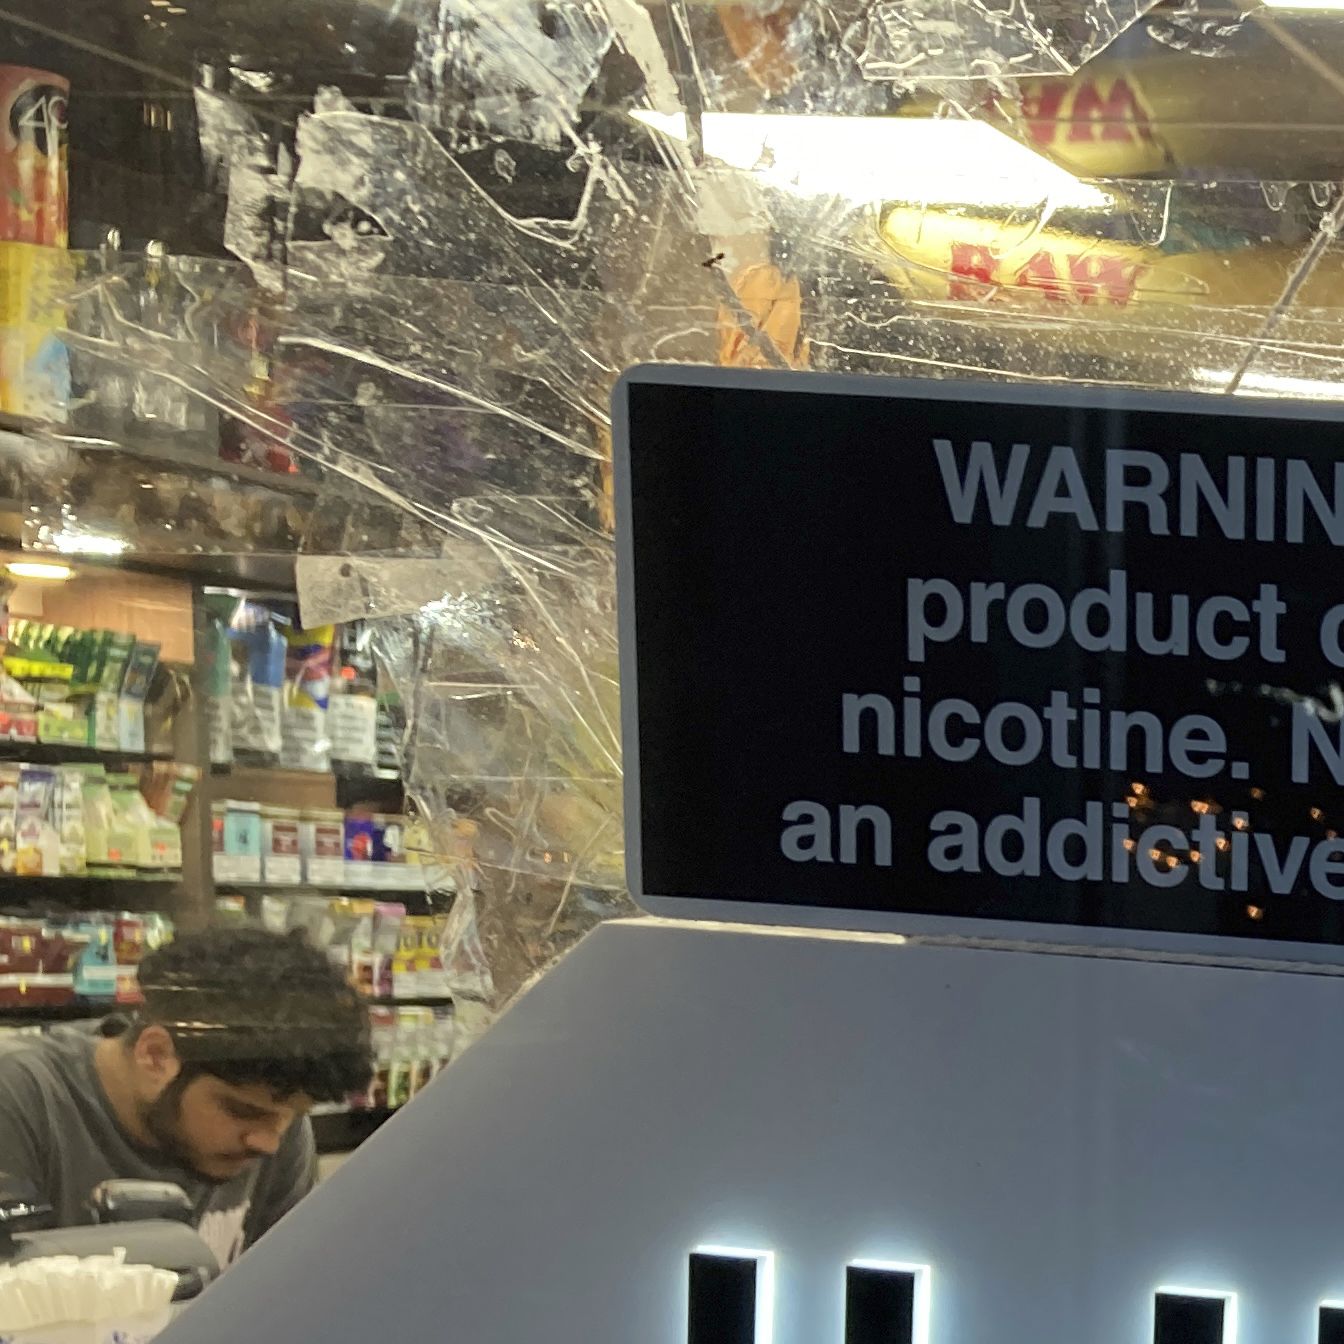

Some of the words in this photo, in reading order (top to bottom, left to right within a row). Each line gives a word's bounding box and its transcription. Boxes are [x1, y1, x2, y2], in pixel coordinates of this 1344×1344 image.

[903, 568, 1287, 664] product
[841, 676, 1250, 780] nicotine.
[779, 800, 892, 867] an
